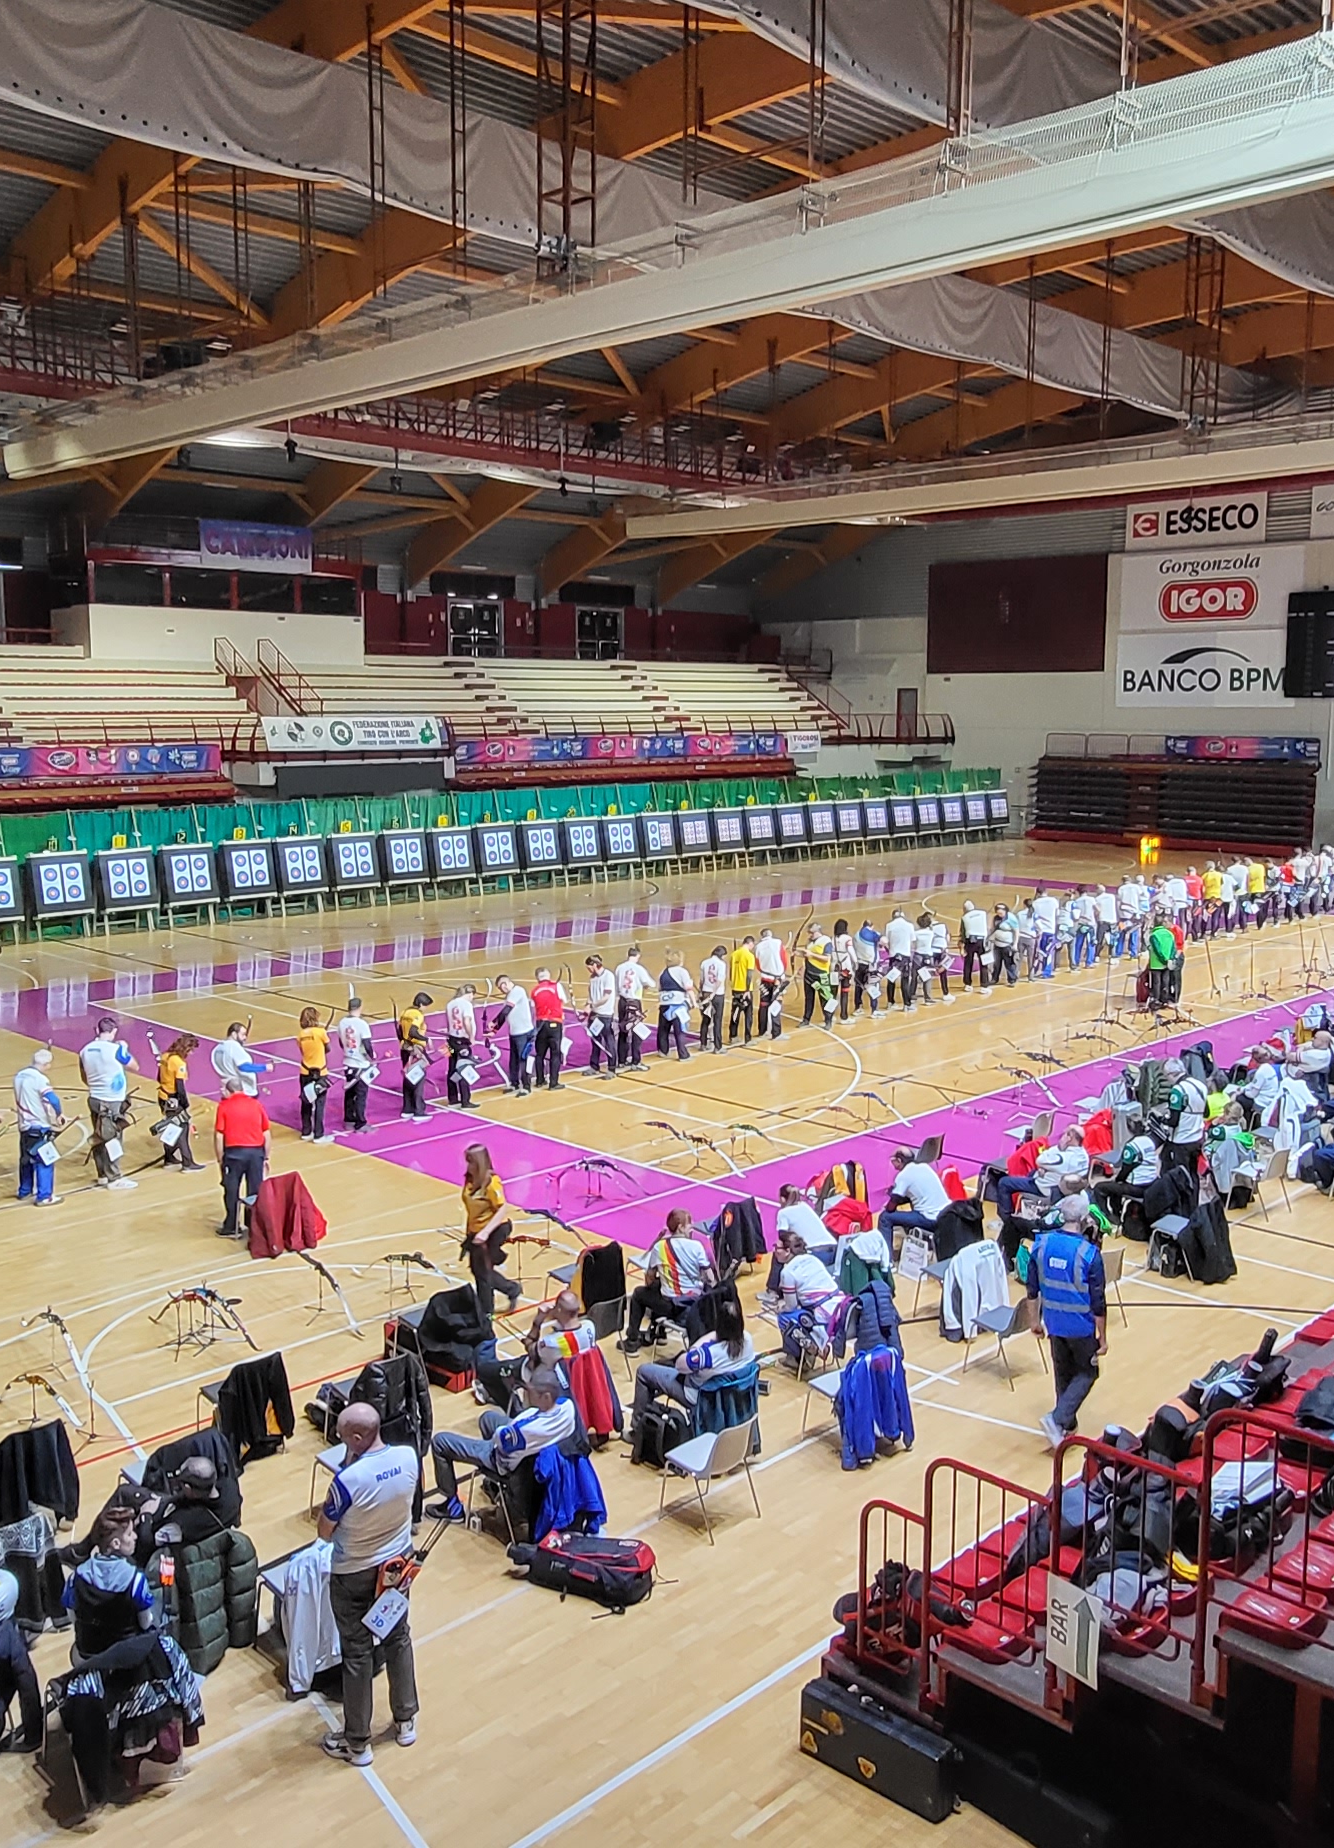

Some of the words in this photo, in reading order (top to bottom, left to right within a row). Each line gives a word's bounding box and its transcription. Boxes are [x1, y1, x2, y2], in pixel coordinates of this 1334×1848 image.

[1165, 503, 1259, 536] ESSECO
[205, 528, 310, 560] CAMPIONI
[1159, 554, 1261, 577] Gorgonzola
[1170, 587, 1246, 614] IGOR
[1122, 668, 1222, 692] BANCO
[1229, 667, 1286, 692] BPM
[352, 720, 390, 729] FEDERAZIONE
[391, 720, 415, 728] ITALIANA
[362, 730, 376, 738] TIRO
[377, 730, 389, 738] CON
[114, 838, 124, 848] 11
[176, 832, 186, 843] 12
[235, 829, 244, 839] 13
[375, 1466, 402, 1482] ROVAI
[1051, 1598, 1069, 1646] BAR
